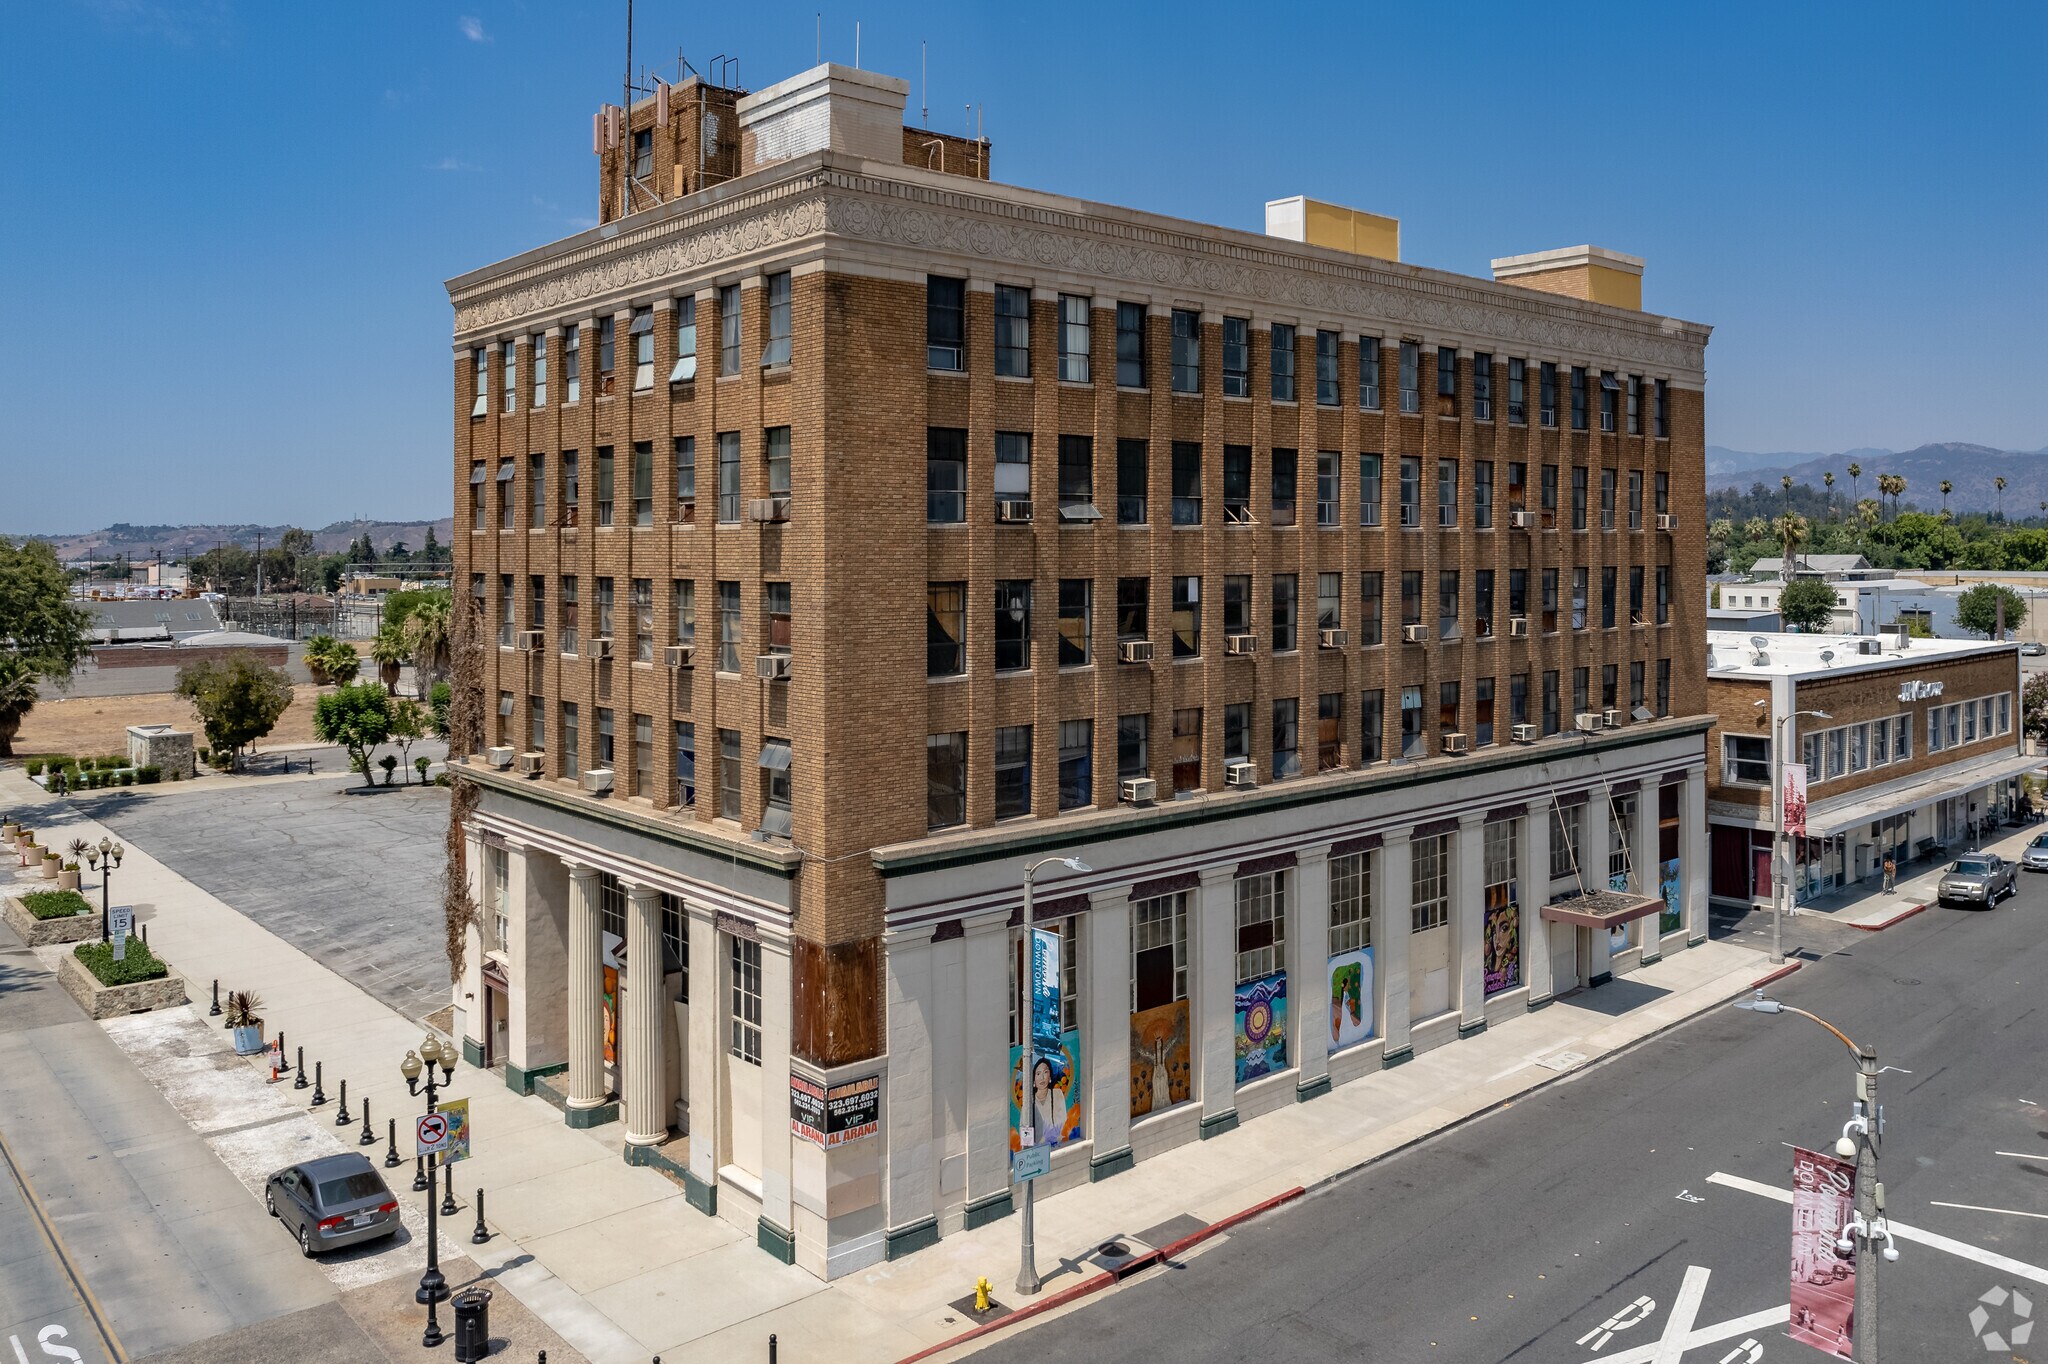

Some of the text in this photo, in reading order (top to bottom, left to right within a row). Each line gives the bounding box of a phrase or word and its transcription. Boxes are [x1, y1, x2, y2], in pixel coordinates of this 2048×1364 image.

[114, 919, 127, 928] 15
[828, 1078, 878, 1101] AVAILABLE
[828, 1090, 878, 1110] 323.697.6032
[792, 1120, 800, 1133] AL
[828, 1133, 841, 1145] AL
[843, 1122, 878, 1142] ARANA
